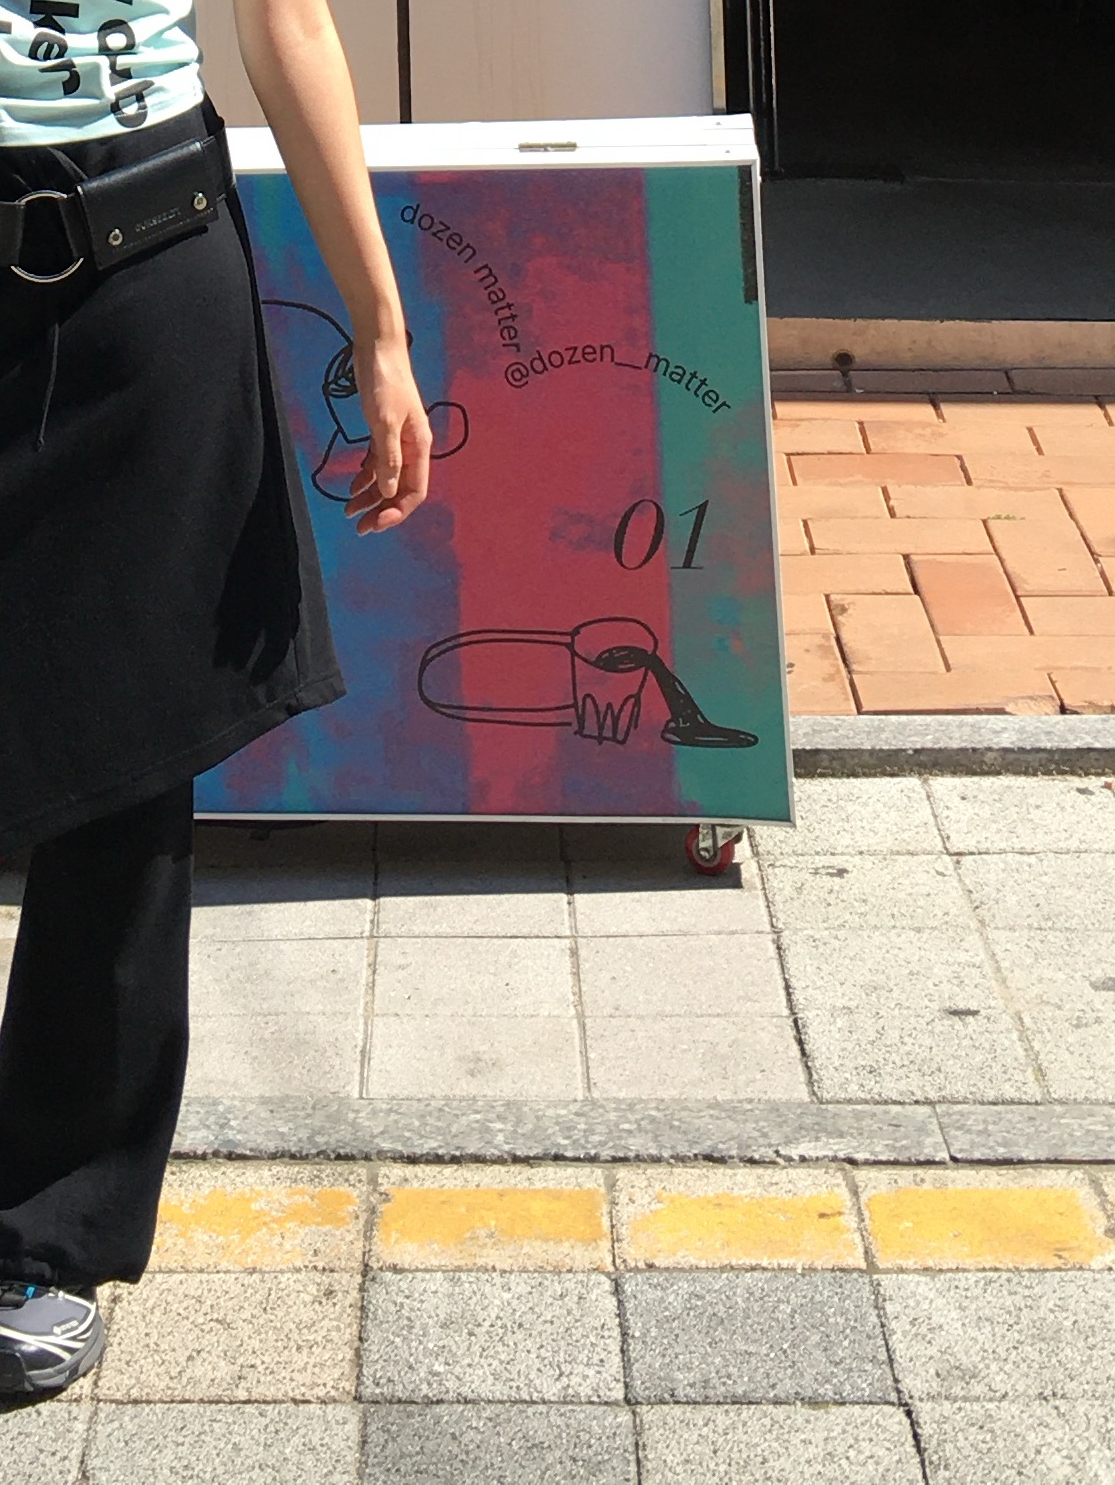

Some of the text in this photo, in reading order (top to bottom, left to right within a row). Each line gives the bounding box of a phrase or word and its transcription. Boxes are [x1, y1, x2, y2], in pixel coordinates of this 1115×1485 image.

[399, 202, 522, 354] dozen matter
[613, 498, 709, 571] 01
